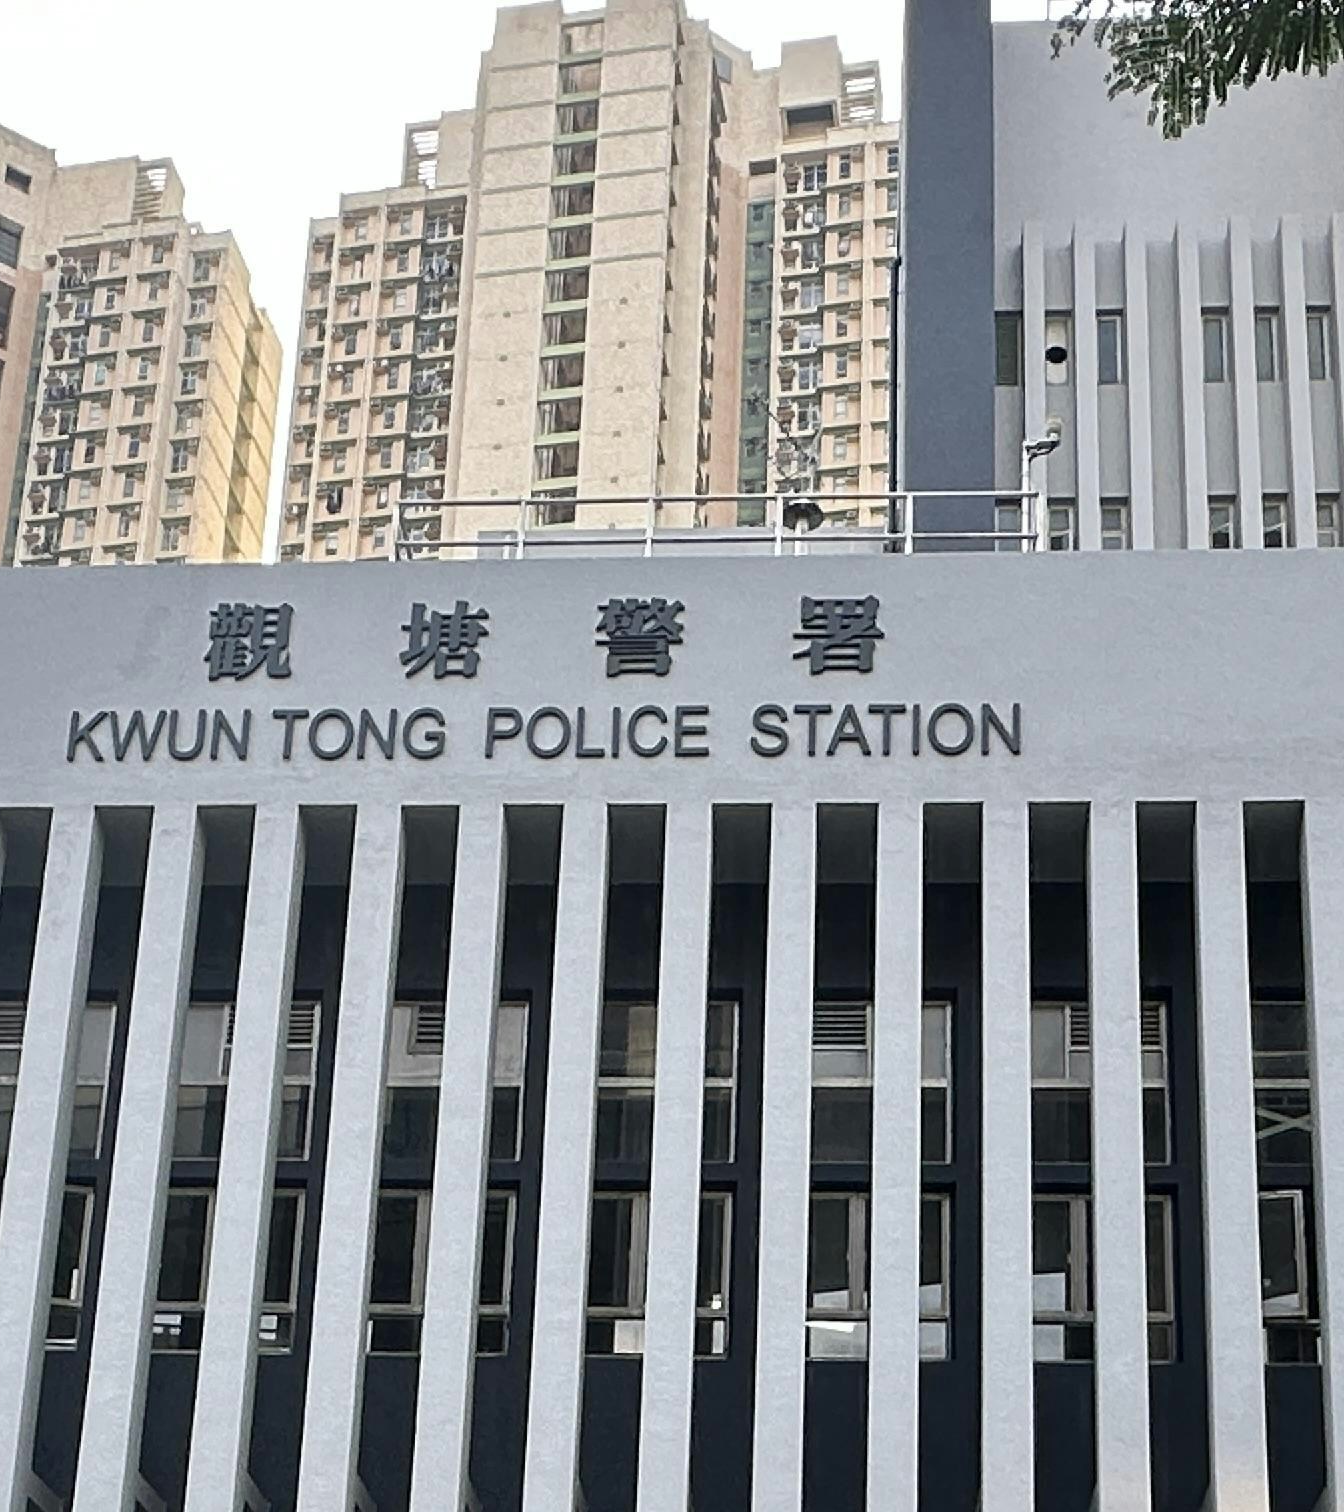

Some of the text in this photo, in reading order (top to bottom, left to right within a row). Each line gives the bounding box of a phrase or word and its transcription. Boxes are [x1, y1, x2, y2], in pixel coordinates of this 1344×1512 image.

[203, 594, 886, 682] 觀塘警署
[65, 702, 1023, 763] KWUN TONG POLICE STATION
